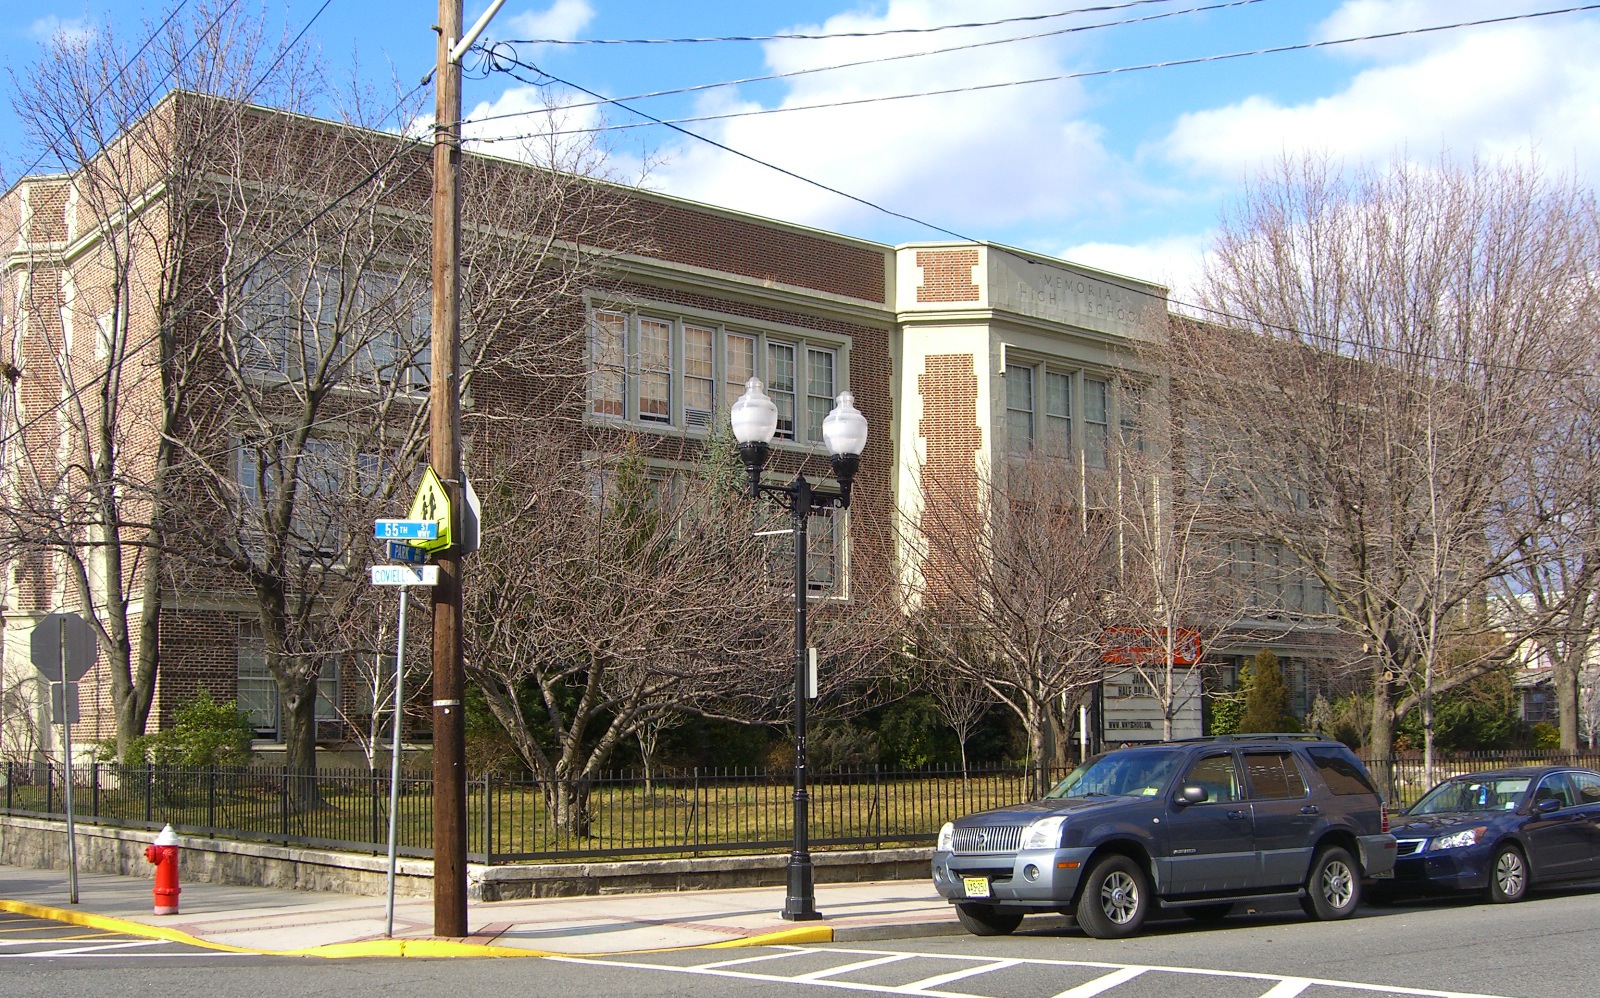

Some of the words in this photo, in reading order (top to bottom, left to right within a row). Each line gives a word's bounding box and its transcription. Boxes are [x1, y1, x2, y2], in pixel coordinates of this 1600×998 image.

[1042, 274, 1122, 303] MEMORIAL
[385, 523, 408, 537] 55TH
[394, 545, 410, 560] PARK
